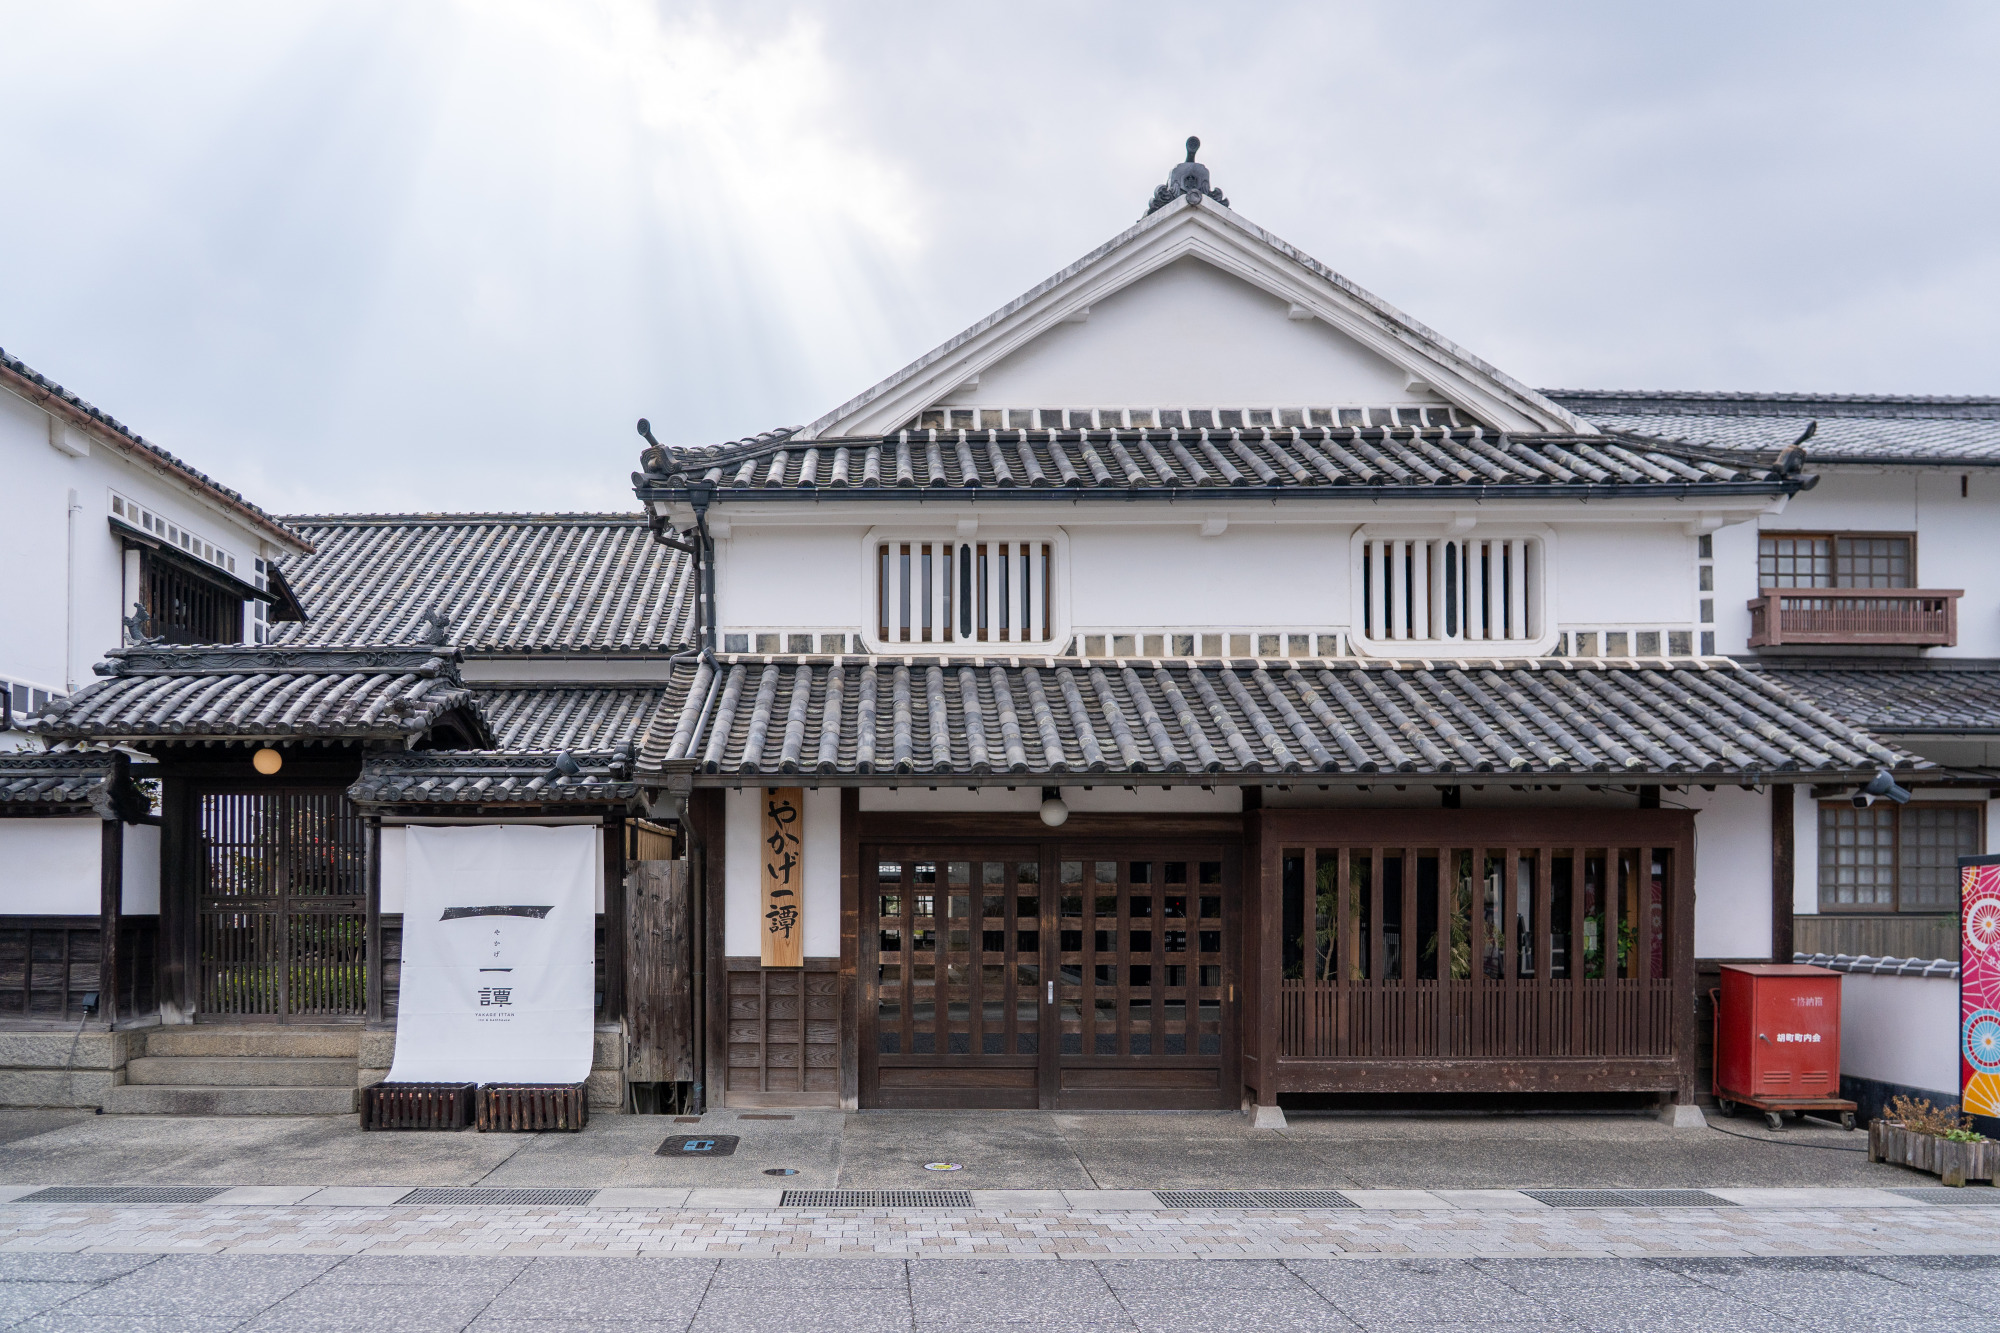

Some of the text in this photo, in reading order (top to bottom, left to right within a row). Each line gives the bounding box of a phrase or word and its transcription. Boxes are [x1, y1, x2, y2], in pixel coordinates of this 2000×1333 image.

[766, 801, 800, 938] やかげ一譚
[1790, 996, 1824, 1007] 格納箱
[1776, 1033, 1821, 1043] 胡町町内会
